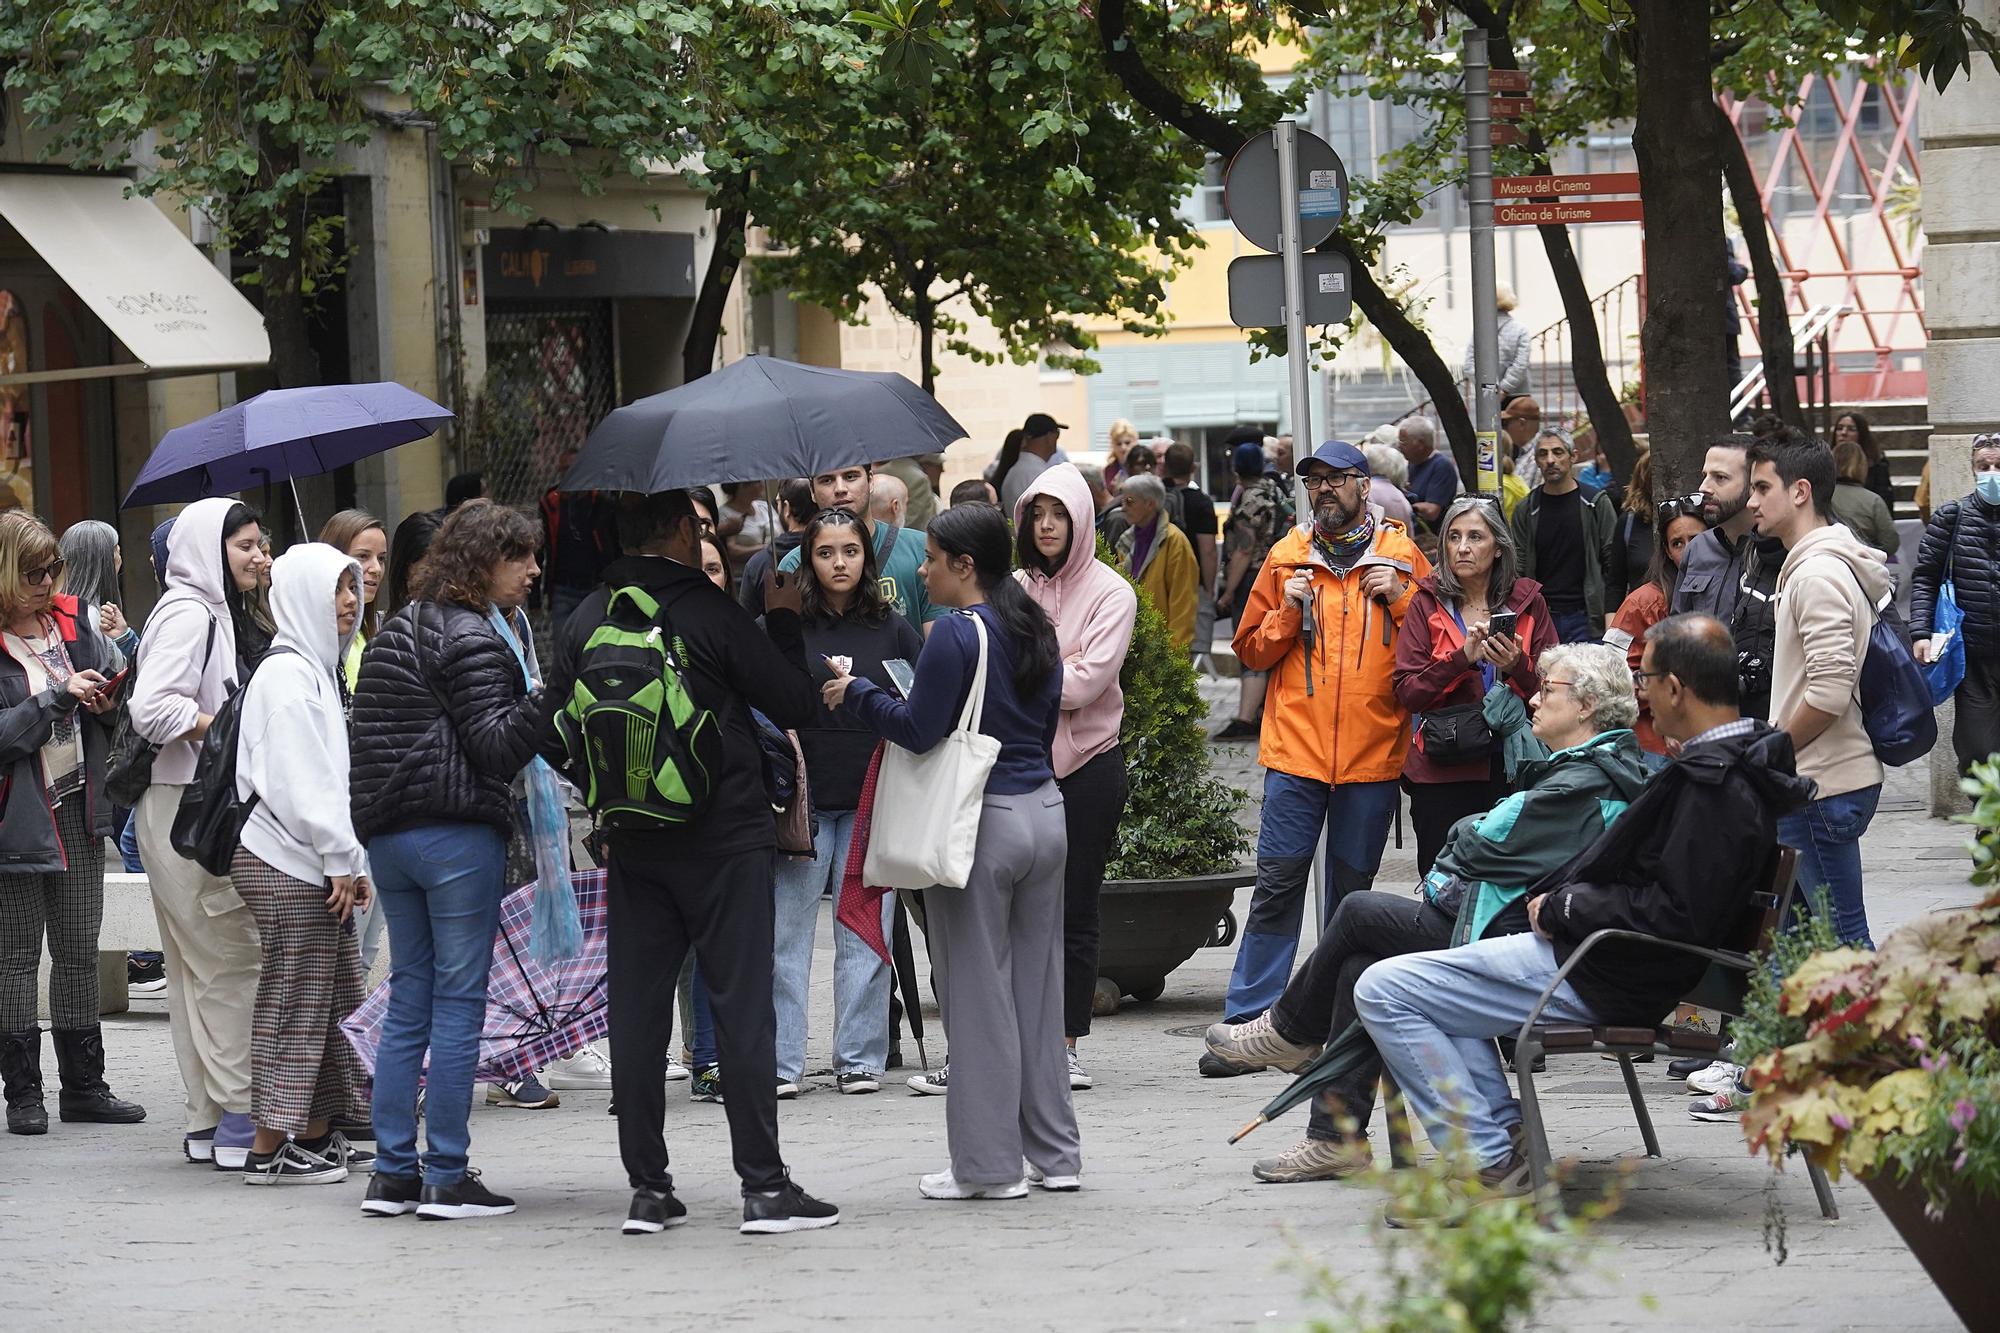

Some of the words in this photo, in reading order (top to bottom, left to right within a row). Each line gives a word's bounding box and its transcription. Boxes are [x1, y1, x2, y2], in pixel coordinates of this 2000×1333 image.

[1500, 182, 1532, 194] Museu
[1535, 180, 1550, 192] del
[1553, 180, 1591, 192] Cinema
[1501, 208, 1537, 222] Oficina
[1539, 207, 1553, 220] de
[1555, 207, 1592, 220] Turisme
